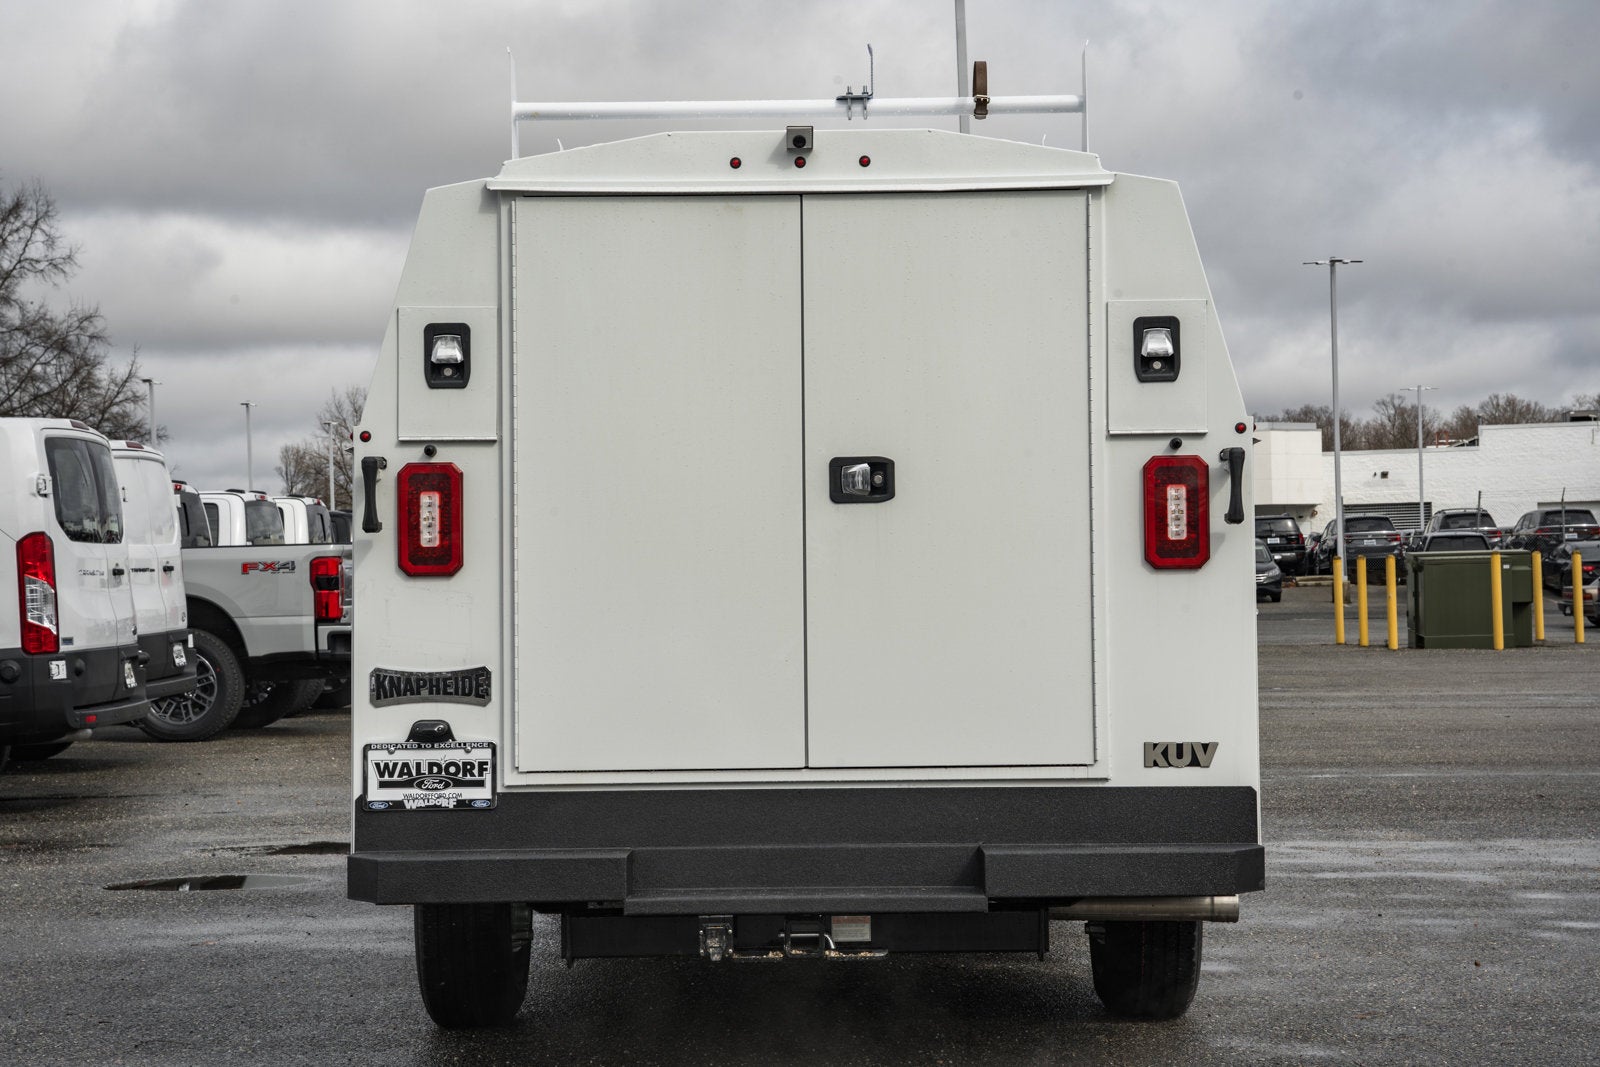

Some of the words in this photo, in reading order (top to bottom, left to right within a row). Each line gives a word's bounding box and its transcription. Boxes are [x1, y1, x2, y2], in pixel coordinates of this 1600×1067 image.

[241, 561, 296, 575] FX4
[375, 673, 489, 700] KNAPHEIDE
[1144, 741, 1219, 768] KUV
[373, 760, 489, 779] WALDORF
[421, 779, 446, 790] Ford
[402, 792, 463, 800] WALDORFFORD.COM
